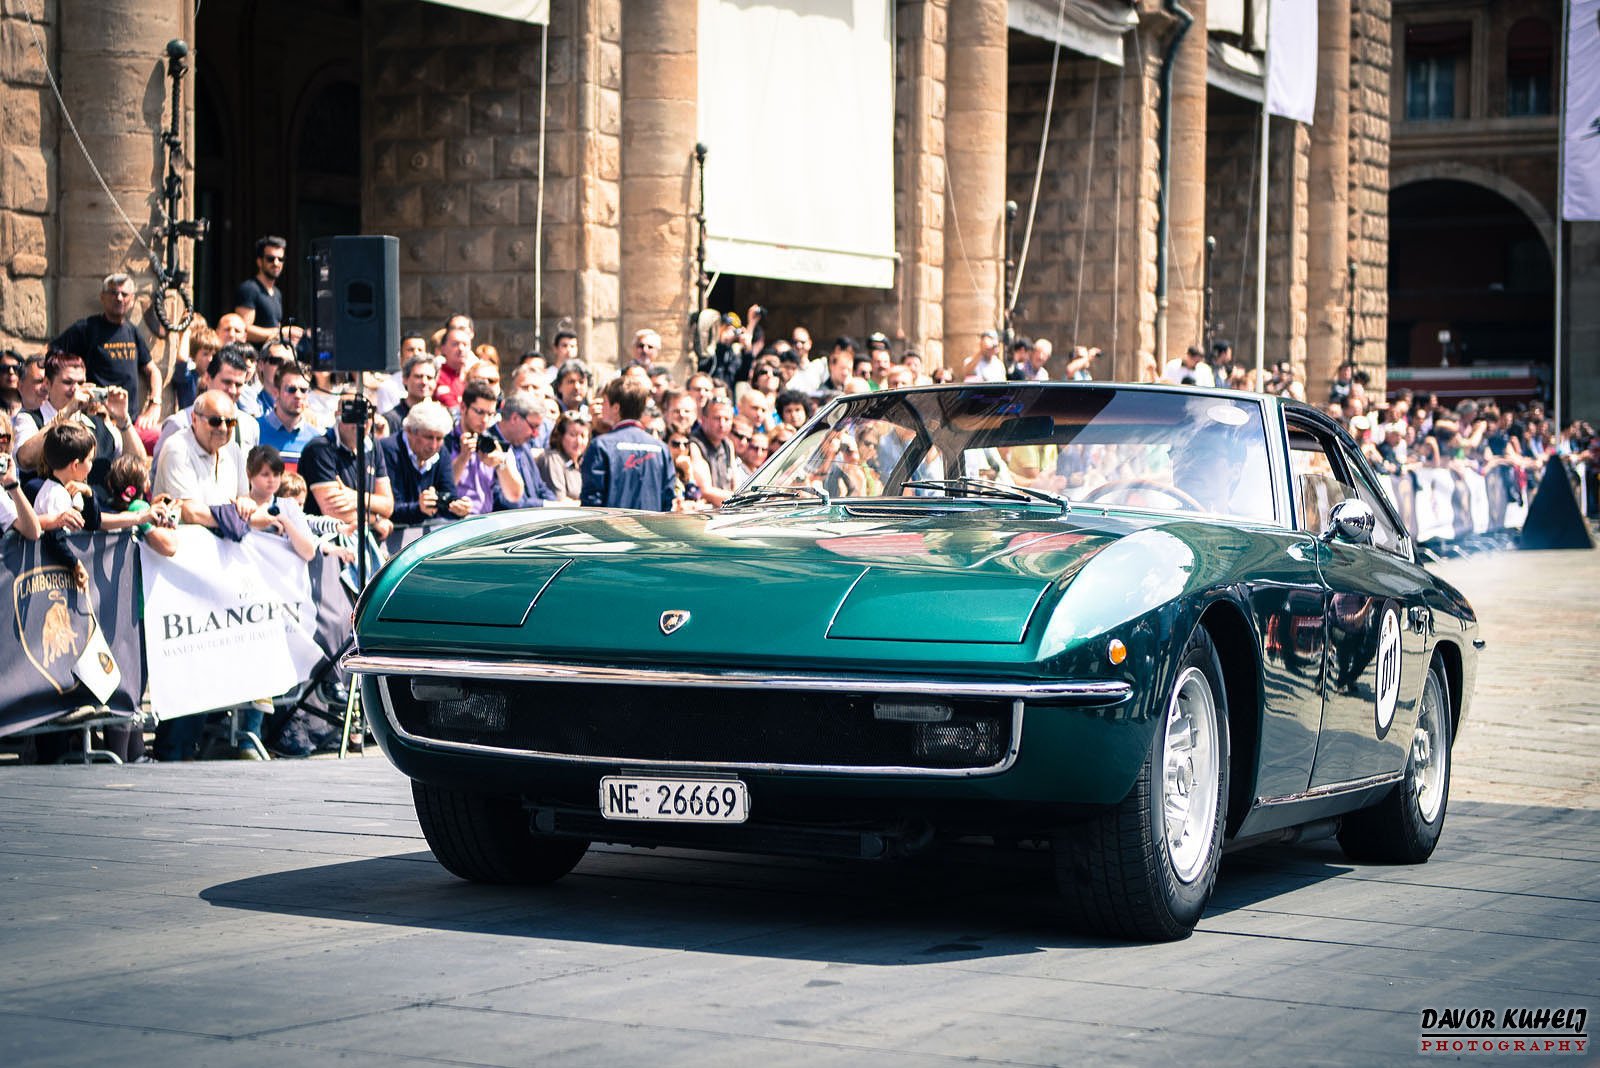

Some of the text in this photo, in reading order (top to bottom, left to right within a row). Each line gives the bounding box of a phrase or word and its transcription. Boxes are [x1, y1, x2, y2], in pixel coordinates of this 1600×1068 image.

[1380, 637, 1397, 701] 011
[608, 783, 737, 818] NE 26669
